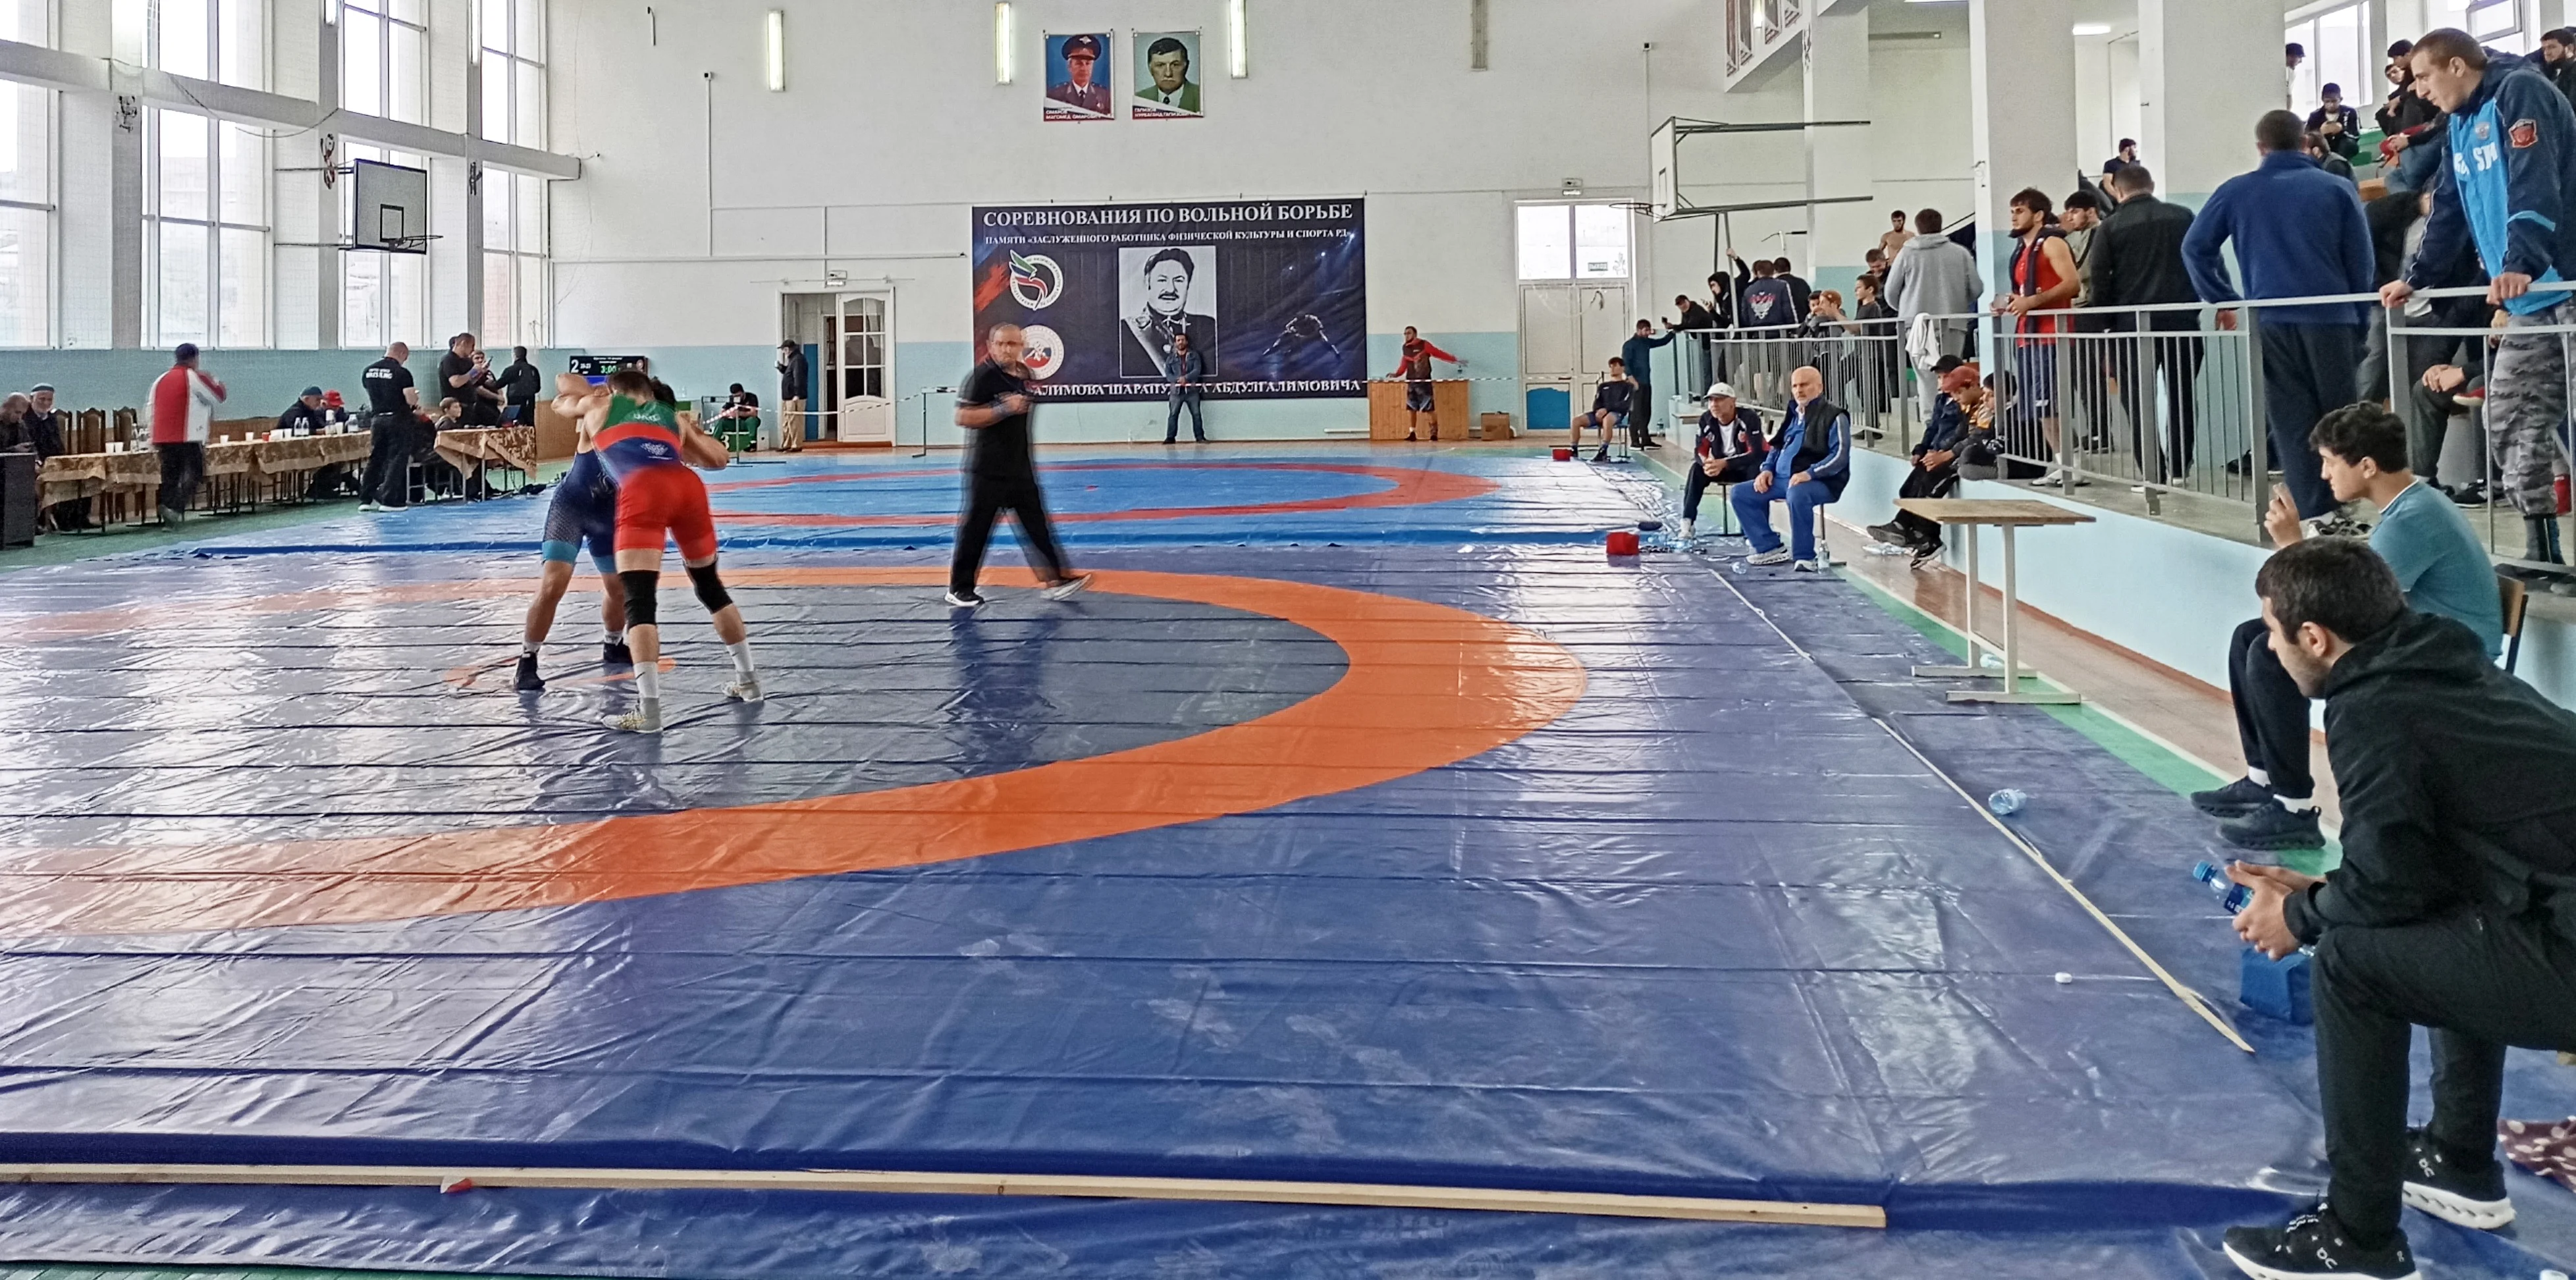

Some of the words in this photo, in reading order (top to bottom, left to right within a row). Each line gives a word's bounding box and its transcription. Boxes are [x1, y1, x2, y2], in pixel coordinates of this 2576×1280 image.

[983, 209, 1141, 227] СОРЕВНОВАНИЯ
[1146, 207, 1174, 223] ПО
[1179, 203, 1273, 223] ВОЛЬНОЙ
[1277, 203, 1353, 221] БОРЬБЕ
[985, 236, 1026, 245] ПАМЯТИ
[1111, 232, 1166, 242] РАБОТНИКА
[1168, 230, 1232, 241] ФИЗИЧЕСКОЙ
[1235, 230, 1285, 240] КУЛЬТУРЫ
[1296, 229, 1334, 238] СПОРТА
[570, 359, 579, 373] 2
[1034, 383, 1105, 396] АЛИМОВА
[1212, 380, 1361, 394] АБДУЛГАЛИМОВИЧА
